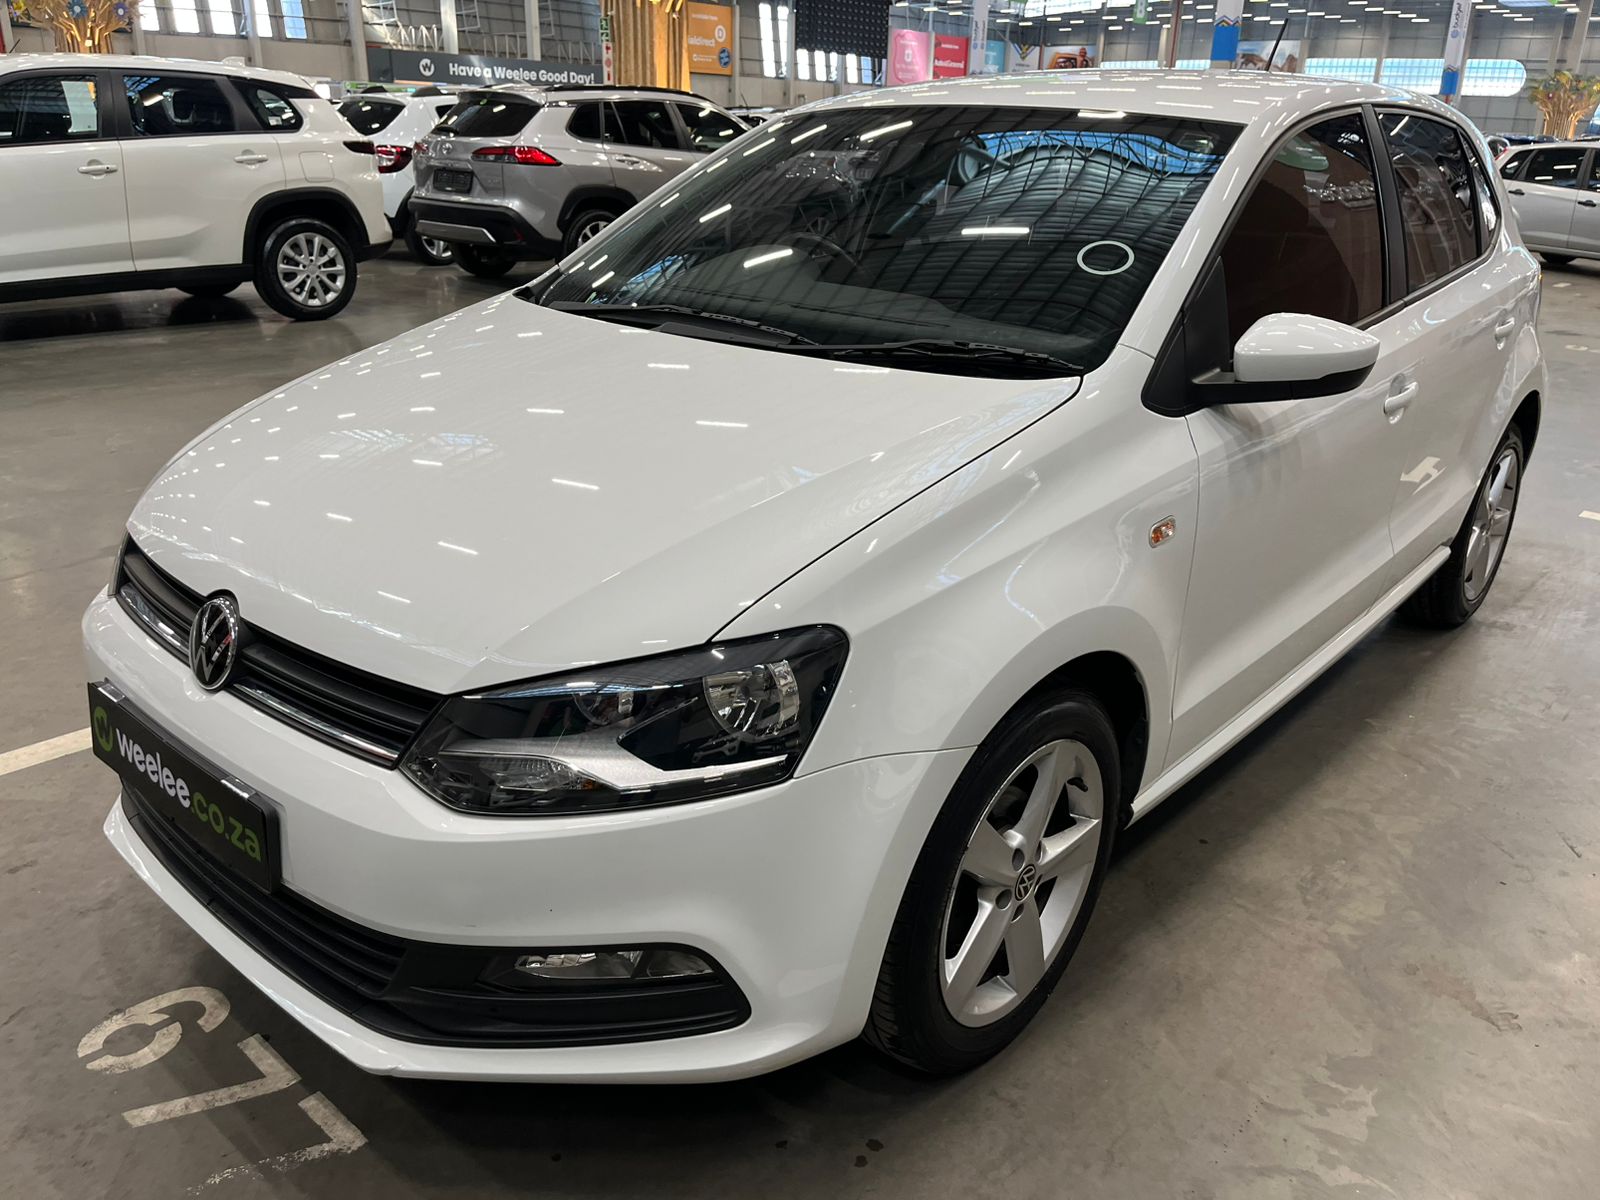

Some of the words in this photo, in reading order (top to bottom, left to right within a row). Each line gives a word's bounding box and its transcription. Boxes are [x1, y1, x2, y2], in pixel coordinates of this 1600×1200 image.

[449, 63, 482, 77] Have
[483, 67, 492, 78] a
[494, 66, 537, 80] Weelee
[539, 70, 568, 83] Good
[569, 71, 596, 84] Day!
[116, 728, 262, 862] weelee.co.za
